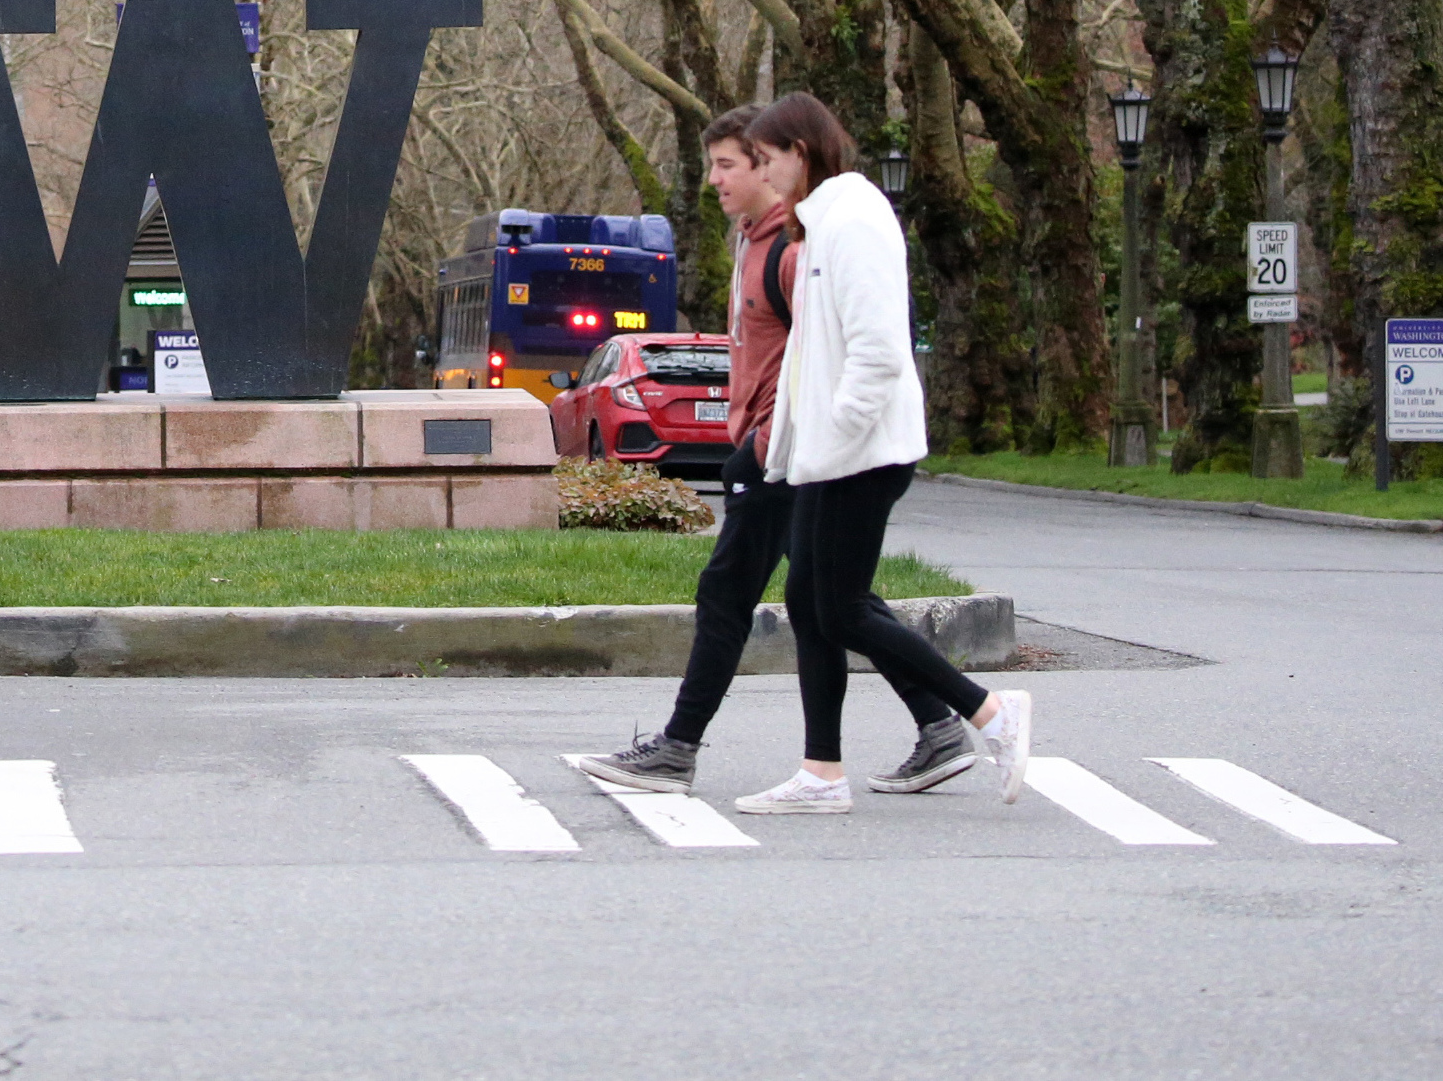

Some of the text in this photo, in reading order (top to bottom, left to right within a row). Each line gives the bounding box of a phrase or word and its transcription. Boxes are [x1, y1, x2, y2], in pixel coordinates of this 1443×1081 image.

[1257, 230, 1288, 241] SPEED
[1260, 243, 1284, 254] LIMIT
[569, 258, 605, 271] 7366
[1258, 258, 1287, 284] 20
[1254, 300, 1291, 308] Enforced
